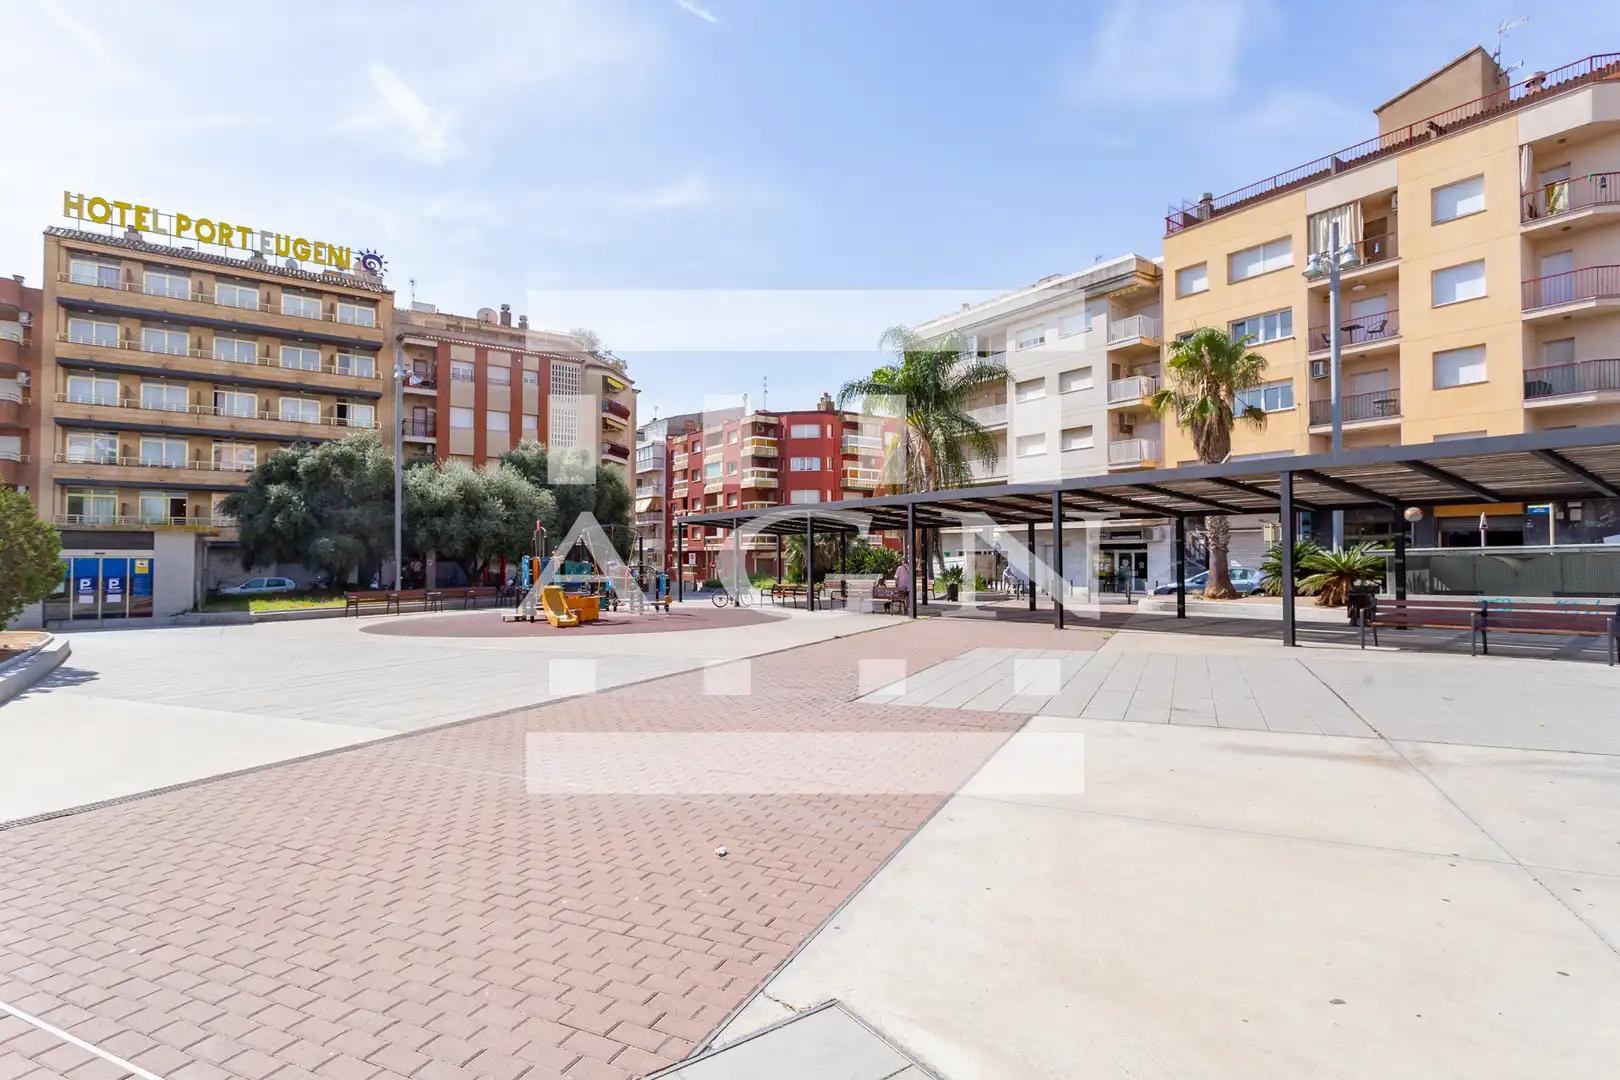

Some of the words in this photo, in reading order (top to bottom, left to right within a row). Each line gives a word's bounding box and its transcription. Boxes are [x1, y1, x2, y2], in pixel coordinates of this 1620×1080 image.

[63, 190, 167, 235] HOTEL
[175, 212, 253, 250] PORT
[260, 230, 351, 270] EUGENI
